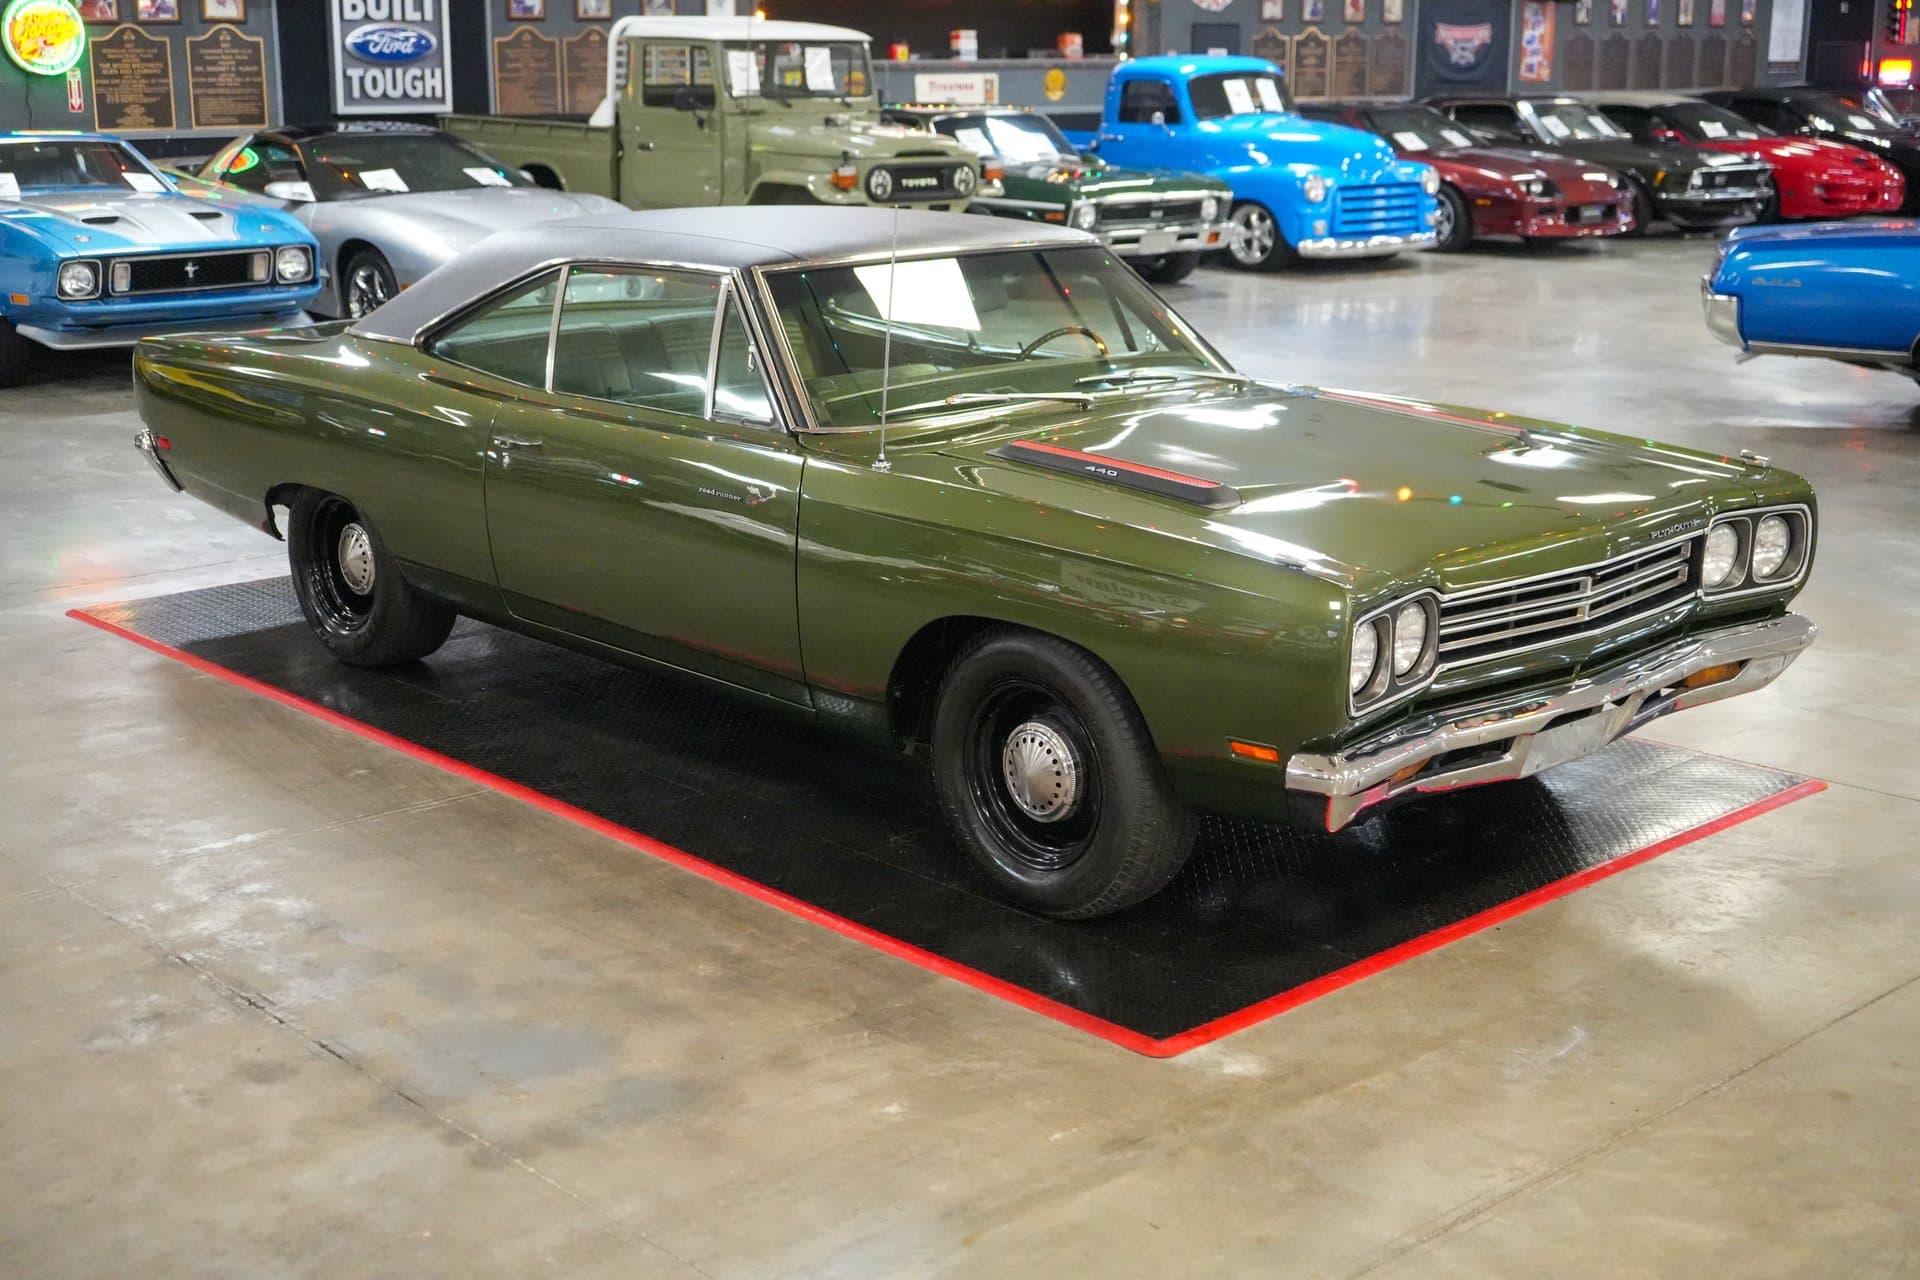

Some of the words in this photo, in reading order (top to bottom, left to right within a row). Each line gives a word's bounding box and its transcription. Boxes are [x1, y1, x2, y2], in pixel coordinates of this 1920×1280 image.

[364, 30, 418, 54] Ford
[346, 67, 442, 99] TOUGH
[901, 177, 938, 188] TOYOTA
[1084, 465, 1118, 477] 440
[1651, 519, 1697, 539] PLYMOUTH
